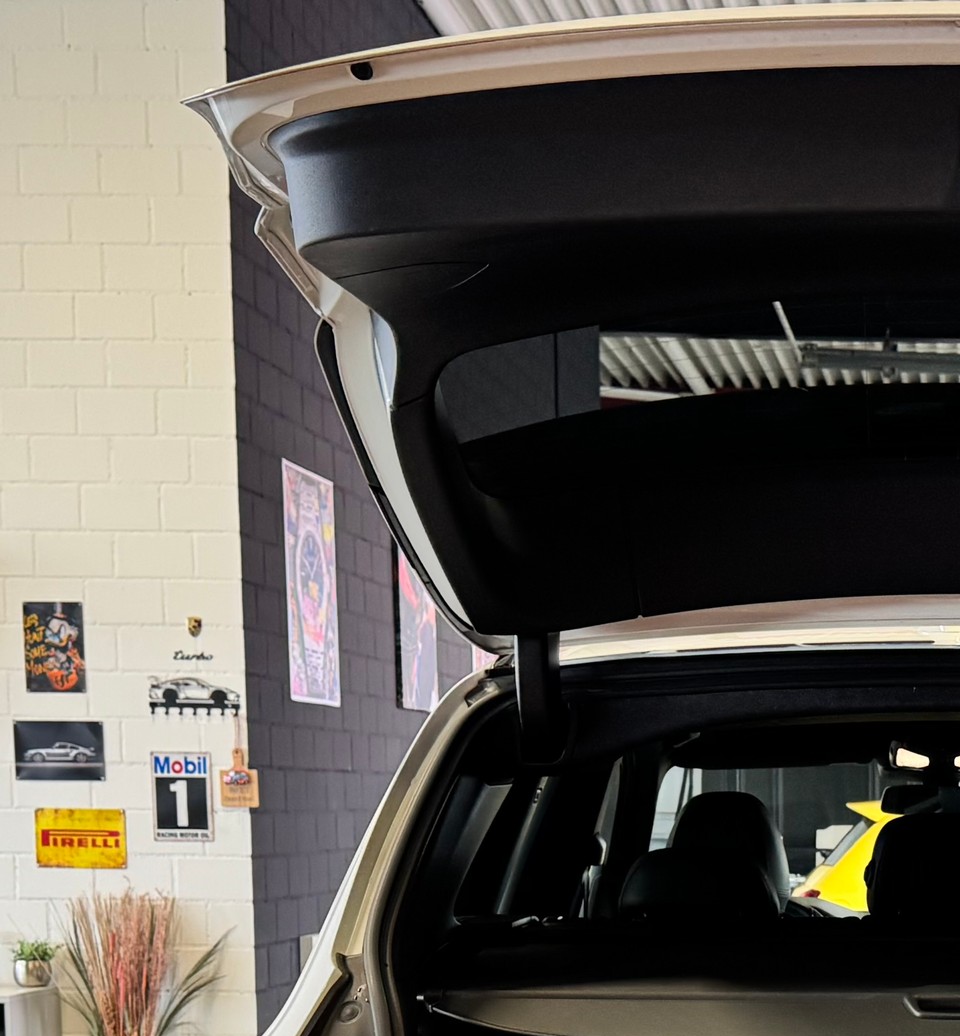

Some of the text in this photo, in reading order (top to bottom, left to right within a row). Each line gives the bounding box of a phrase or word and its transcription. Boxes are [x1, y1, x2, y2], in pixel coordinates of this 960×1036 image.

[173, 650, 213, 660] Turbo
[154, 756, 207, 774] Mobil
[169, 780, 189, 827] 1
[41, 829, 120, 848] PIRELLI
